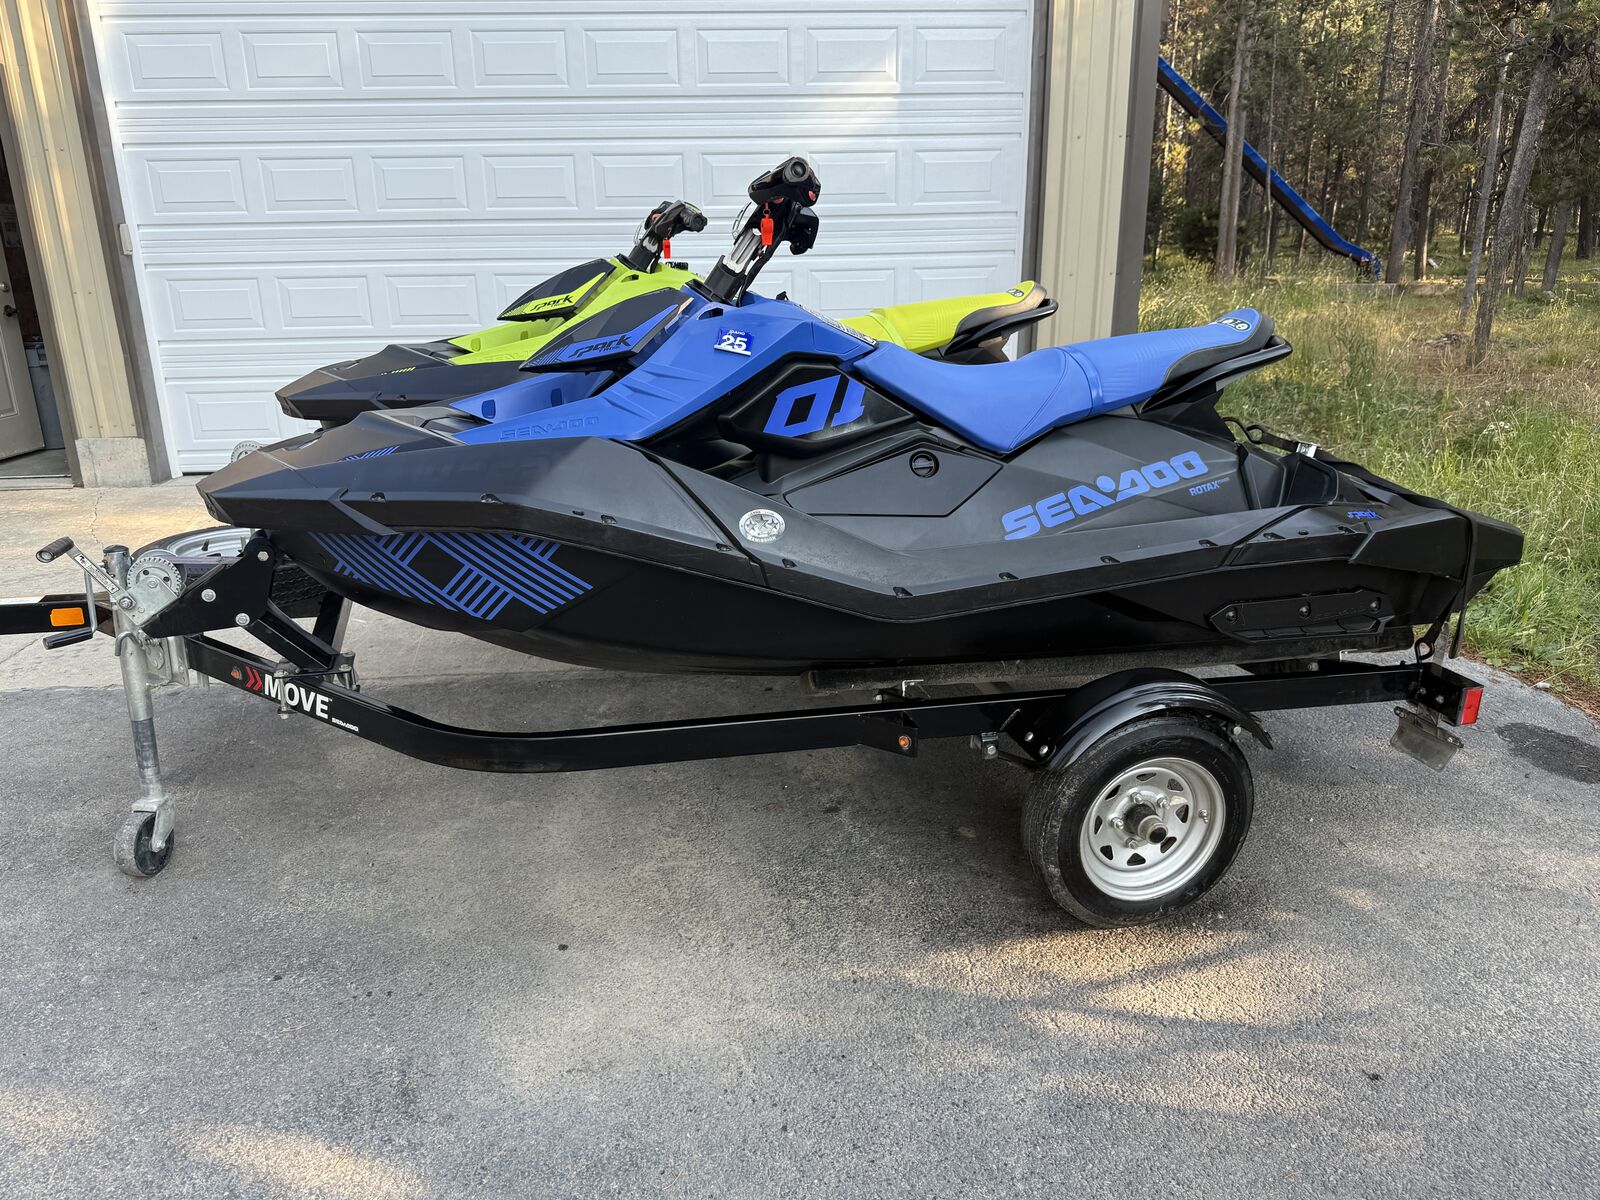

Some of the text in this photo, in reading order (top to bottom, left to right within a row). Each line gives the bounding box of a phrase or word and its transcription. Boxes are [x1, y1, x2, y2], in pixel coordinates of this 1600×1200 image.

[721, 334, 748, 351] 25
[1189, 481, 1220, 497] ROTAX
[264, 673, 329, 719] MOVE
